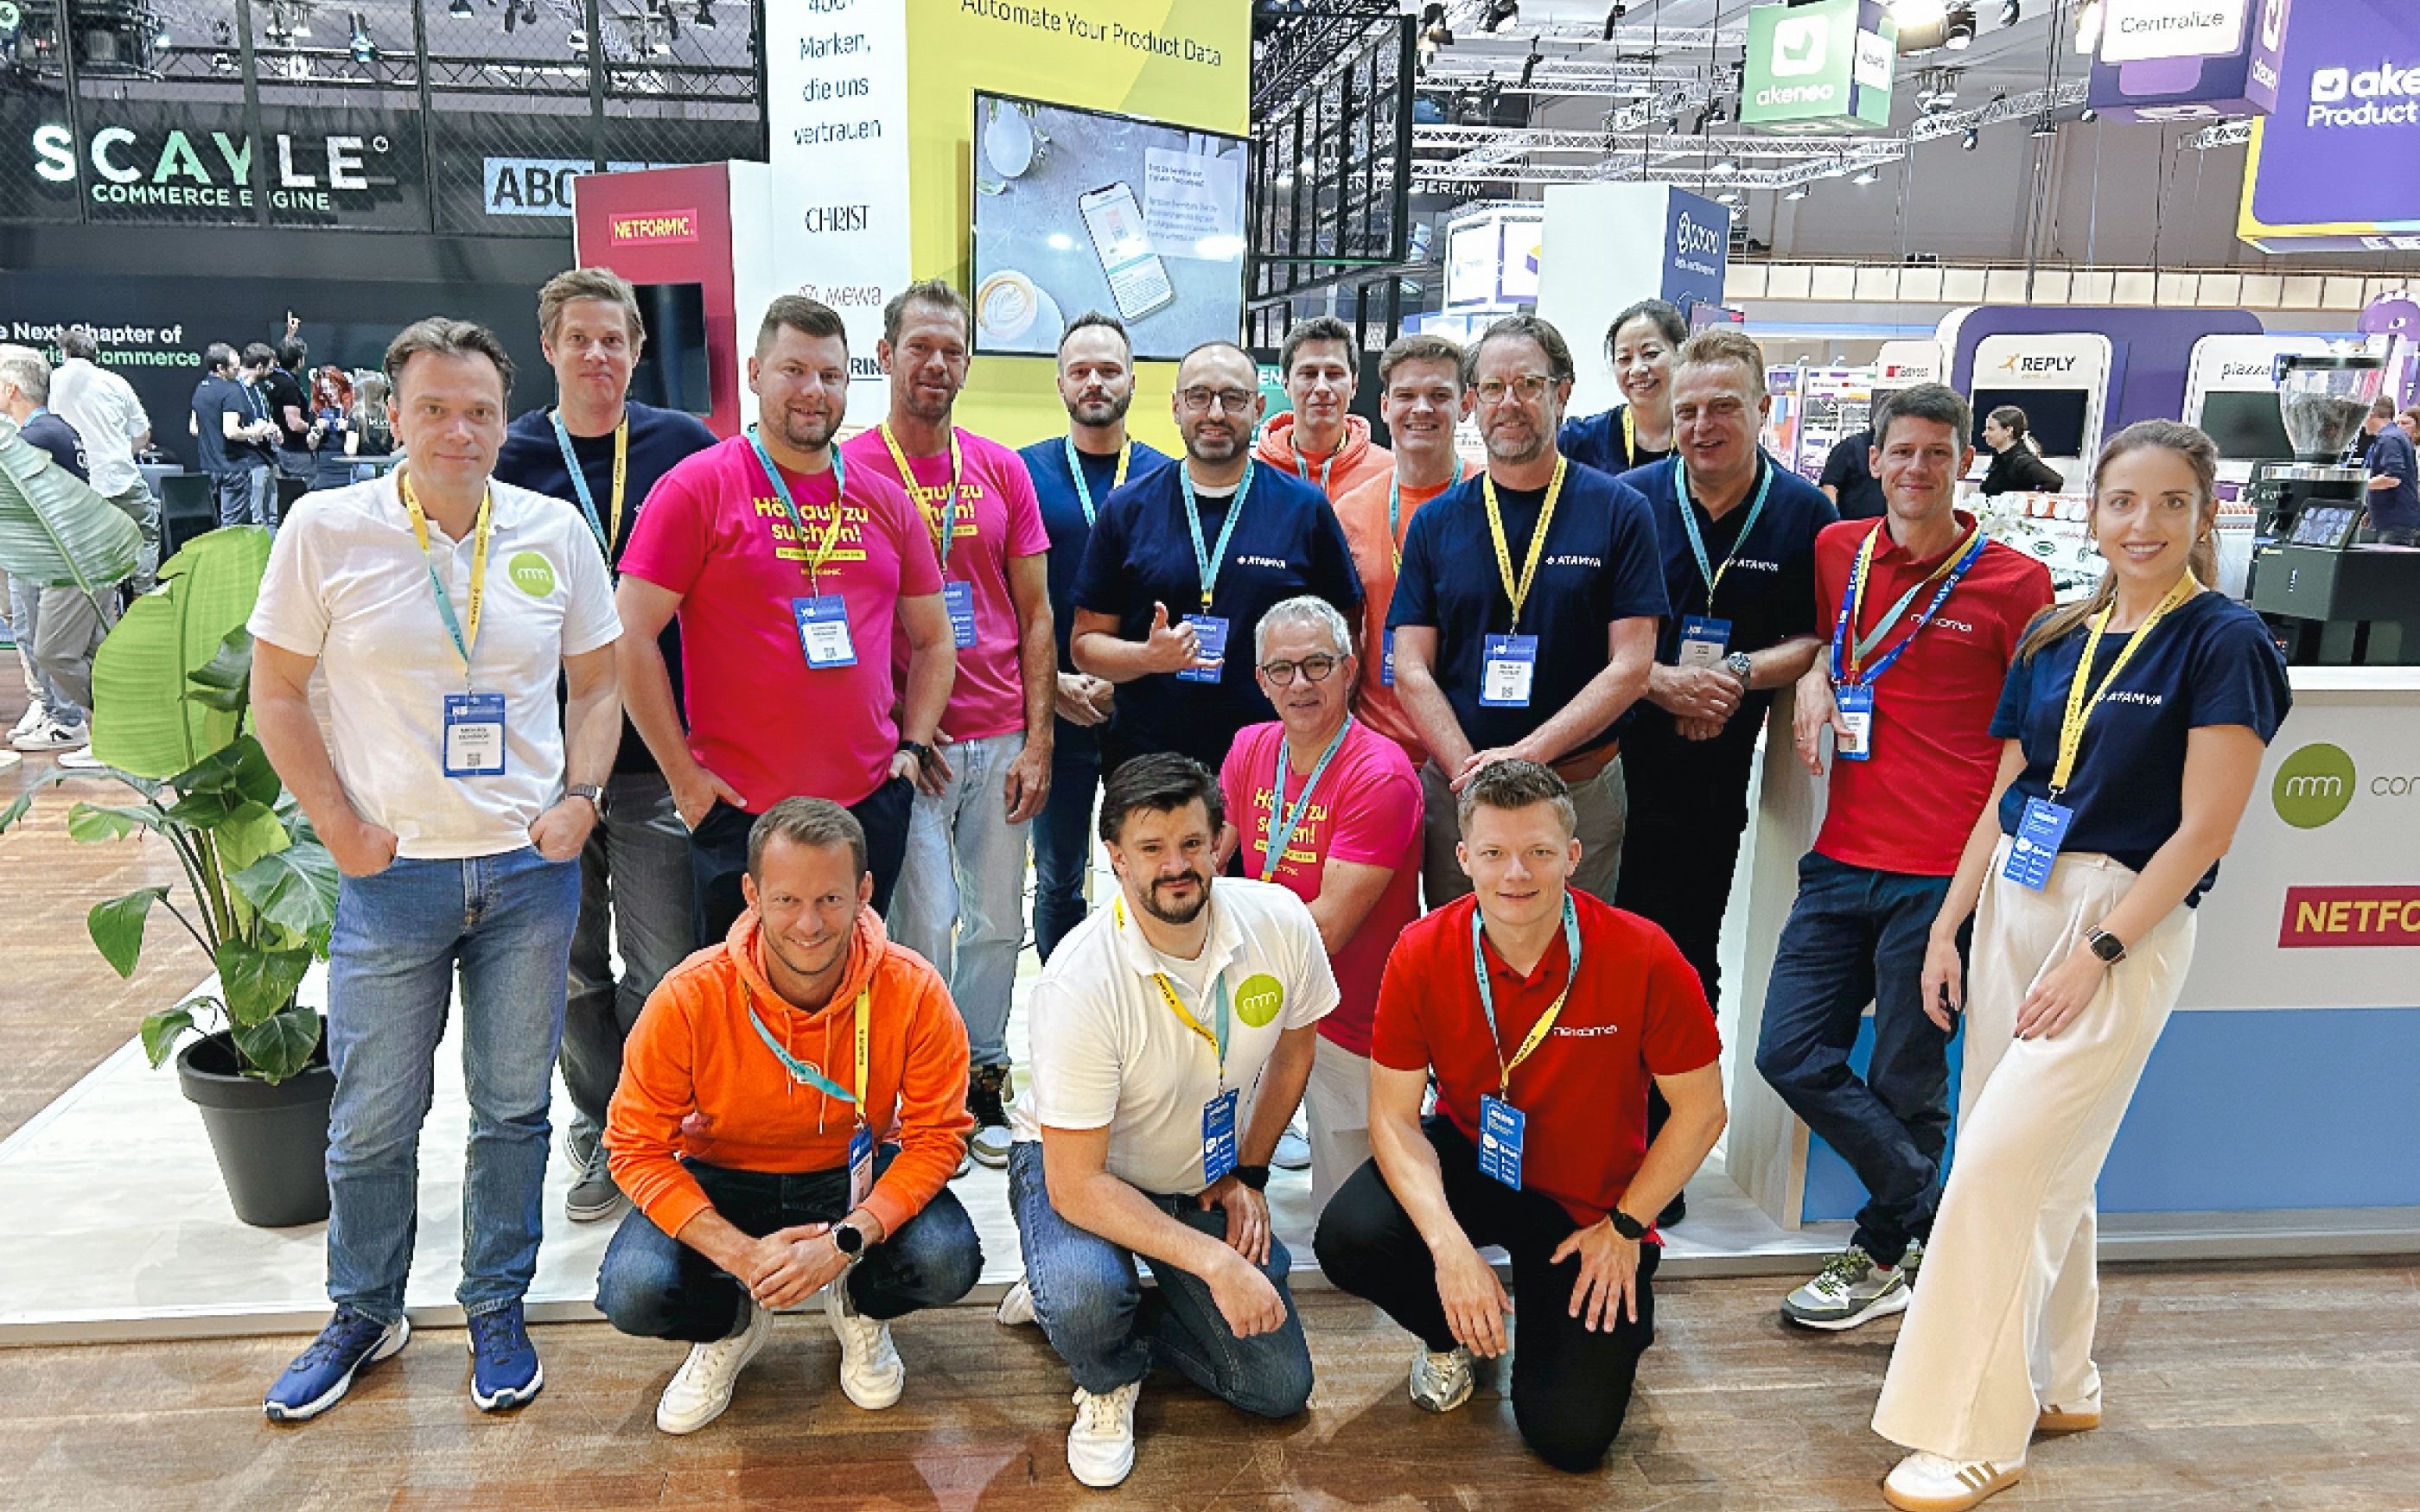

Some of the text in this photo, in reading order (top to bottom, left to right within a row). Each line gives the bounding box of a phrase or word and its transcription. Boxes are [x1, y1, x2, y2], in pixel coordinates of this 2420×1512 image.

[2121, 11, 2225, 34] Centralize
[800, 32, 870, 60] Marken,
[1066, 11, 1108, 41] Your
[1113, 22, 1180, 58] Product
[1184, 39, 1221, 66] Data
[803, 78, 869, 102] die uns
[1756, 85, 1835, 106] akeneo
[2307, 100, 2418, 127] Product
[794, 119, 882, 145] vertrauen
[91, 184, 330, 211] COMMERCE EGINE
[806, 205, 870, 232] CHRIST
[160, 325, 182, 344] of
[2022, 356, 2077, 372] REPLY
[843, 507, 869, 523] zu
